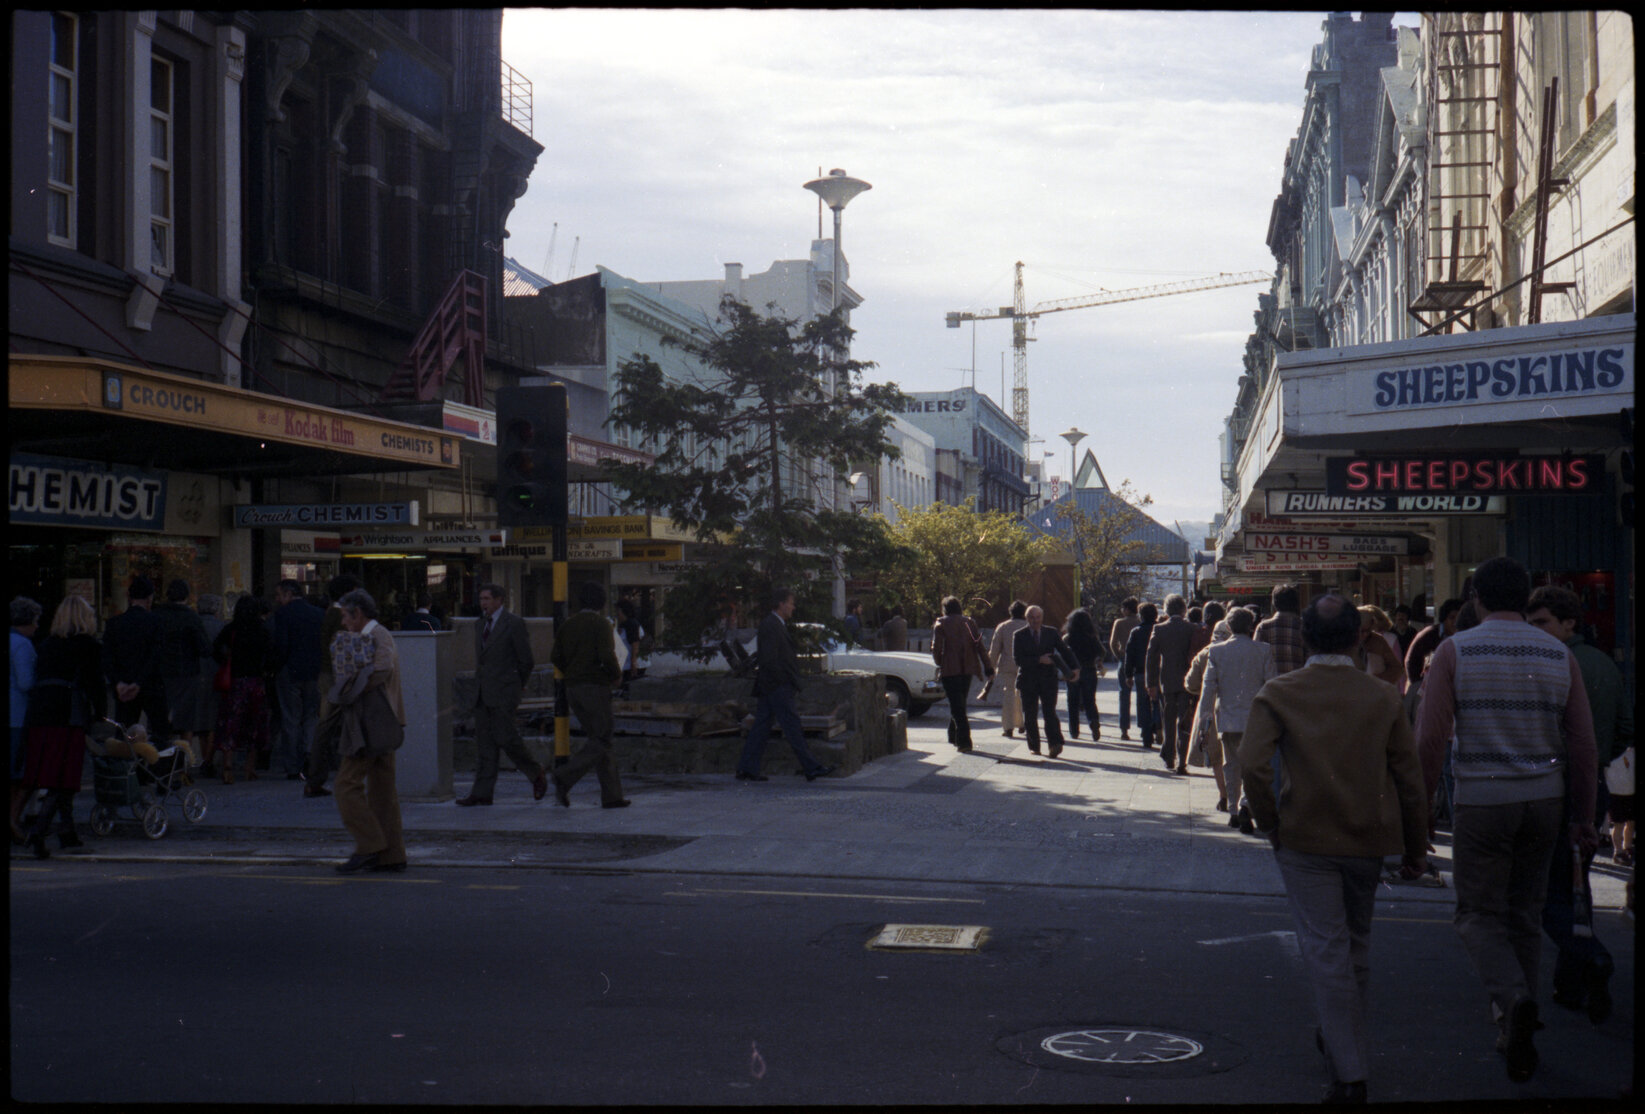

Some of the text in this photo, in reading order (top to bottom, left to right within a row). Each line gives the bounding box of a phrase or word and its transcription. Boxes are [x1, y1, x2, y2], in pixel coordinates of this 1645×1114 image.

[1375, 349, 1624, 407] SHEEPSKINS
[129, 385, 206, 414] CROUCH
[904, 400, 966, 413] MERS
[284, 408, 327, 441] Kodak
[331, 417, 354, 446] film
[381, 433, 434, 454] CHEMISTS
[1346, 458, 1588, 491] SHEEPSKINS
[10, 469, 160, 517] HEMIST
[1289, 493, 1482, 511] RUNNERS WORLD
[241, 506, 404, 524] Crouch CHEMIST
[584, 525, 621, 535] SAVINGS
[624, 525, 645, 534] BANK
[364, 534, 481, 545] Wrightson APPLIANCES
[1255, 535, 1330, 550] NASH'S
[1342, 544, 1397, 552] LUGGAGE
[568, 550, 613, 558] NDCRAFTS
